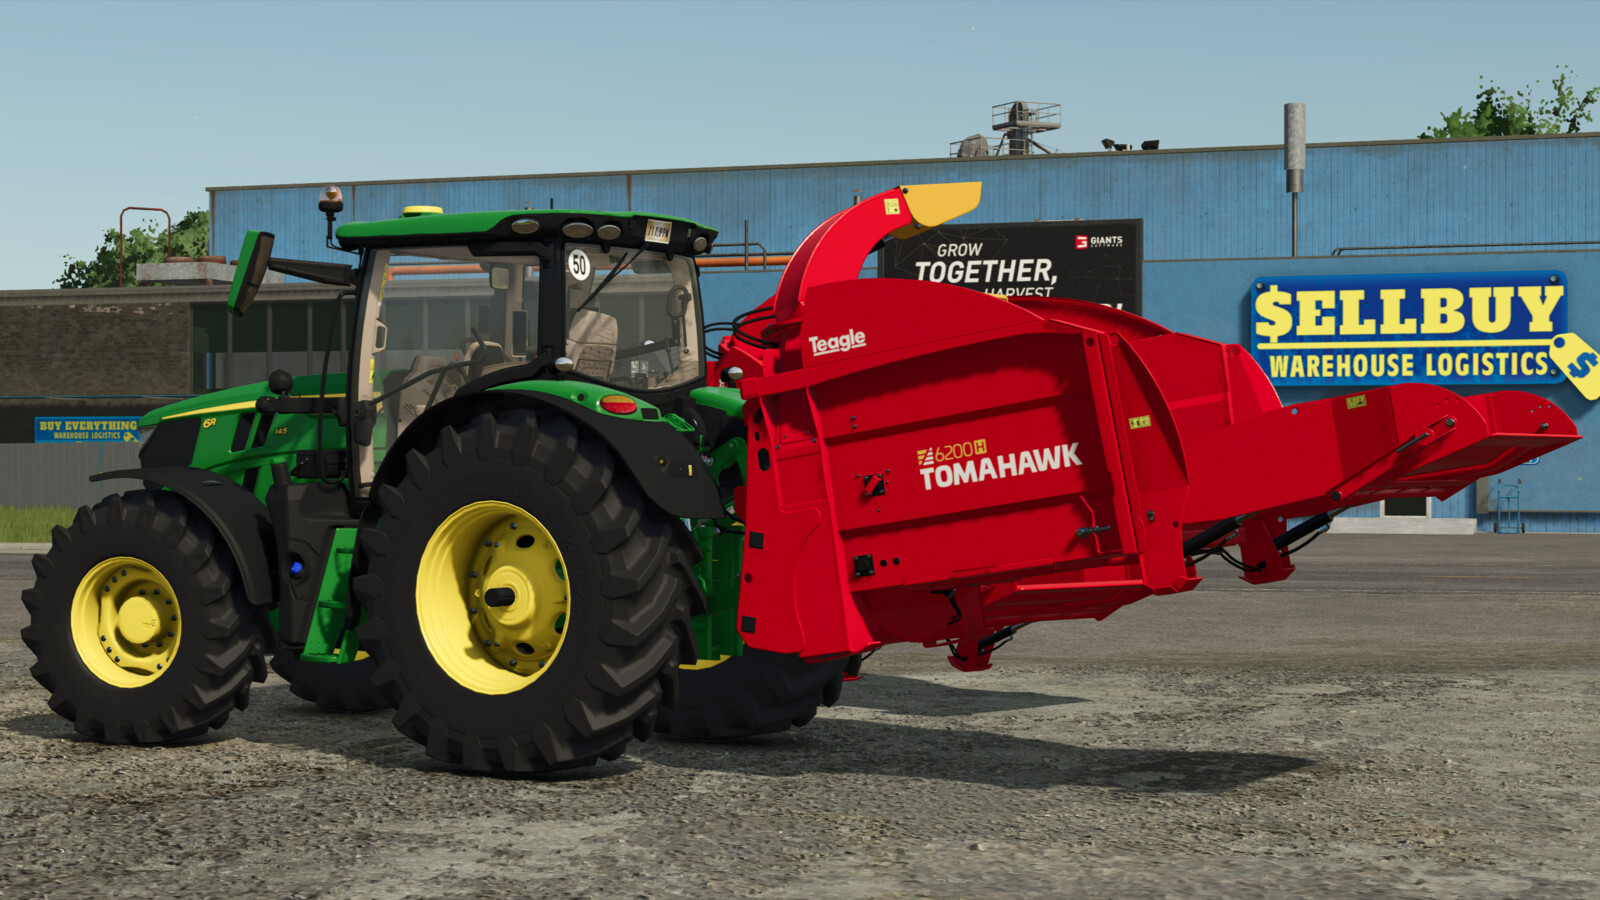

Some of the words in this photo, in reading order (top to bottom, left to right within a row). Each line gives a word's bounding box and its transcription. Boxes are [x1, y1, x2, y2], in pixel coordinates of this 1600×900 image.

[937, 243, 983, 257] GROW
[1090, 236, 1123, 244] GIANTS
[573, 254, 586, 275] 50
[915, 258, 1058, 285] TOGETHER,
[808, 328, 867, 356] Teagle
[1269, 353, 1414, 378] WAREHOUSE
[1426, 351, 1549, 376] LOGISTICS
[40, 421, 62, 430] BUY
[65, 421, 138, 430] EVERYTHING
[203, 418, 217, 428] 6R
[920, 442, 1083, 490] TOMAHAWK
